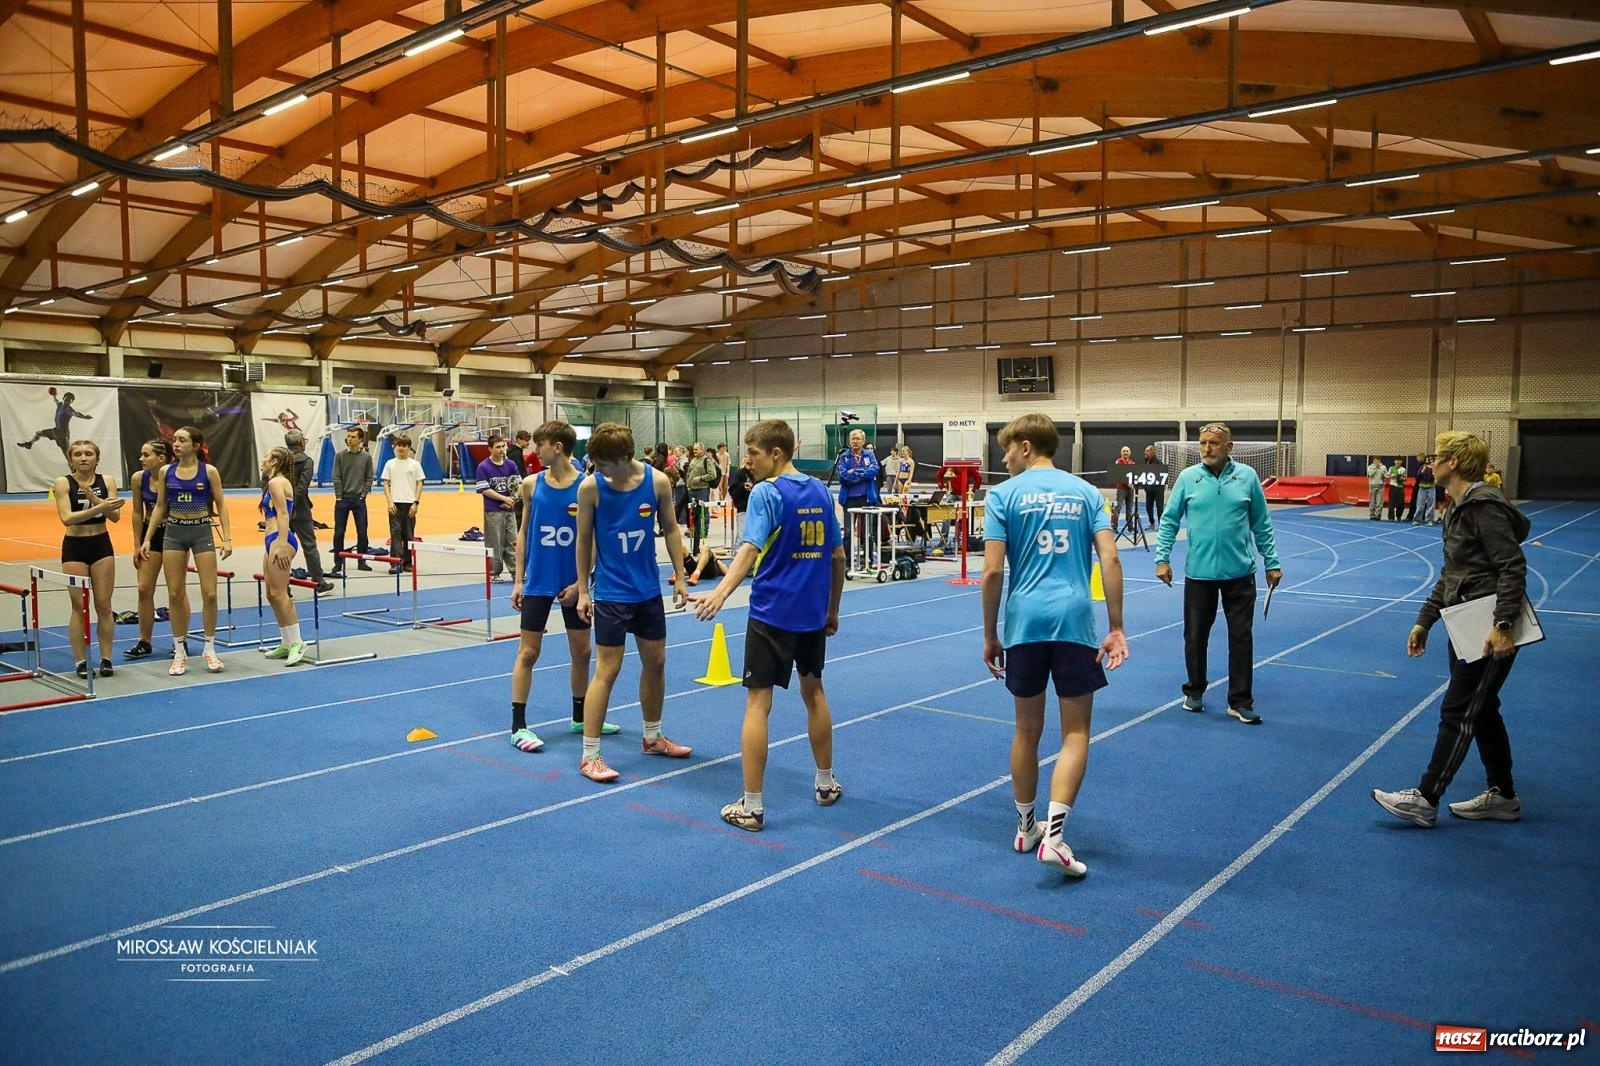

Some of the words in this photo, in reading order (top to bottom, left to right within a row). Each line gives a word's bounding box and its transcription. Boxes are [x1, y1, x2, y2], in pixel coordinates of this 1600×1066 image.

[1126, 472, 1168, 485] 1:49.7
[178, 492, 192, 502] 20
[1020, 492, 1056, 507] JUST
[1044, 502, 1082, 519] TEAM
[540, 526, 574, 547] 20
[618, 529, 646, 554] 17
[1037, 529, 1070, 555] 93
